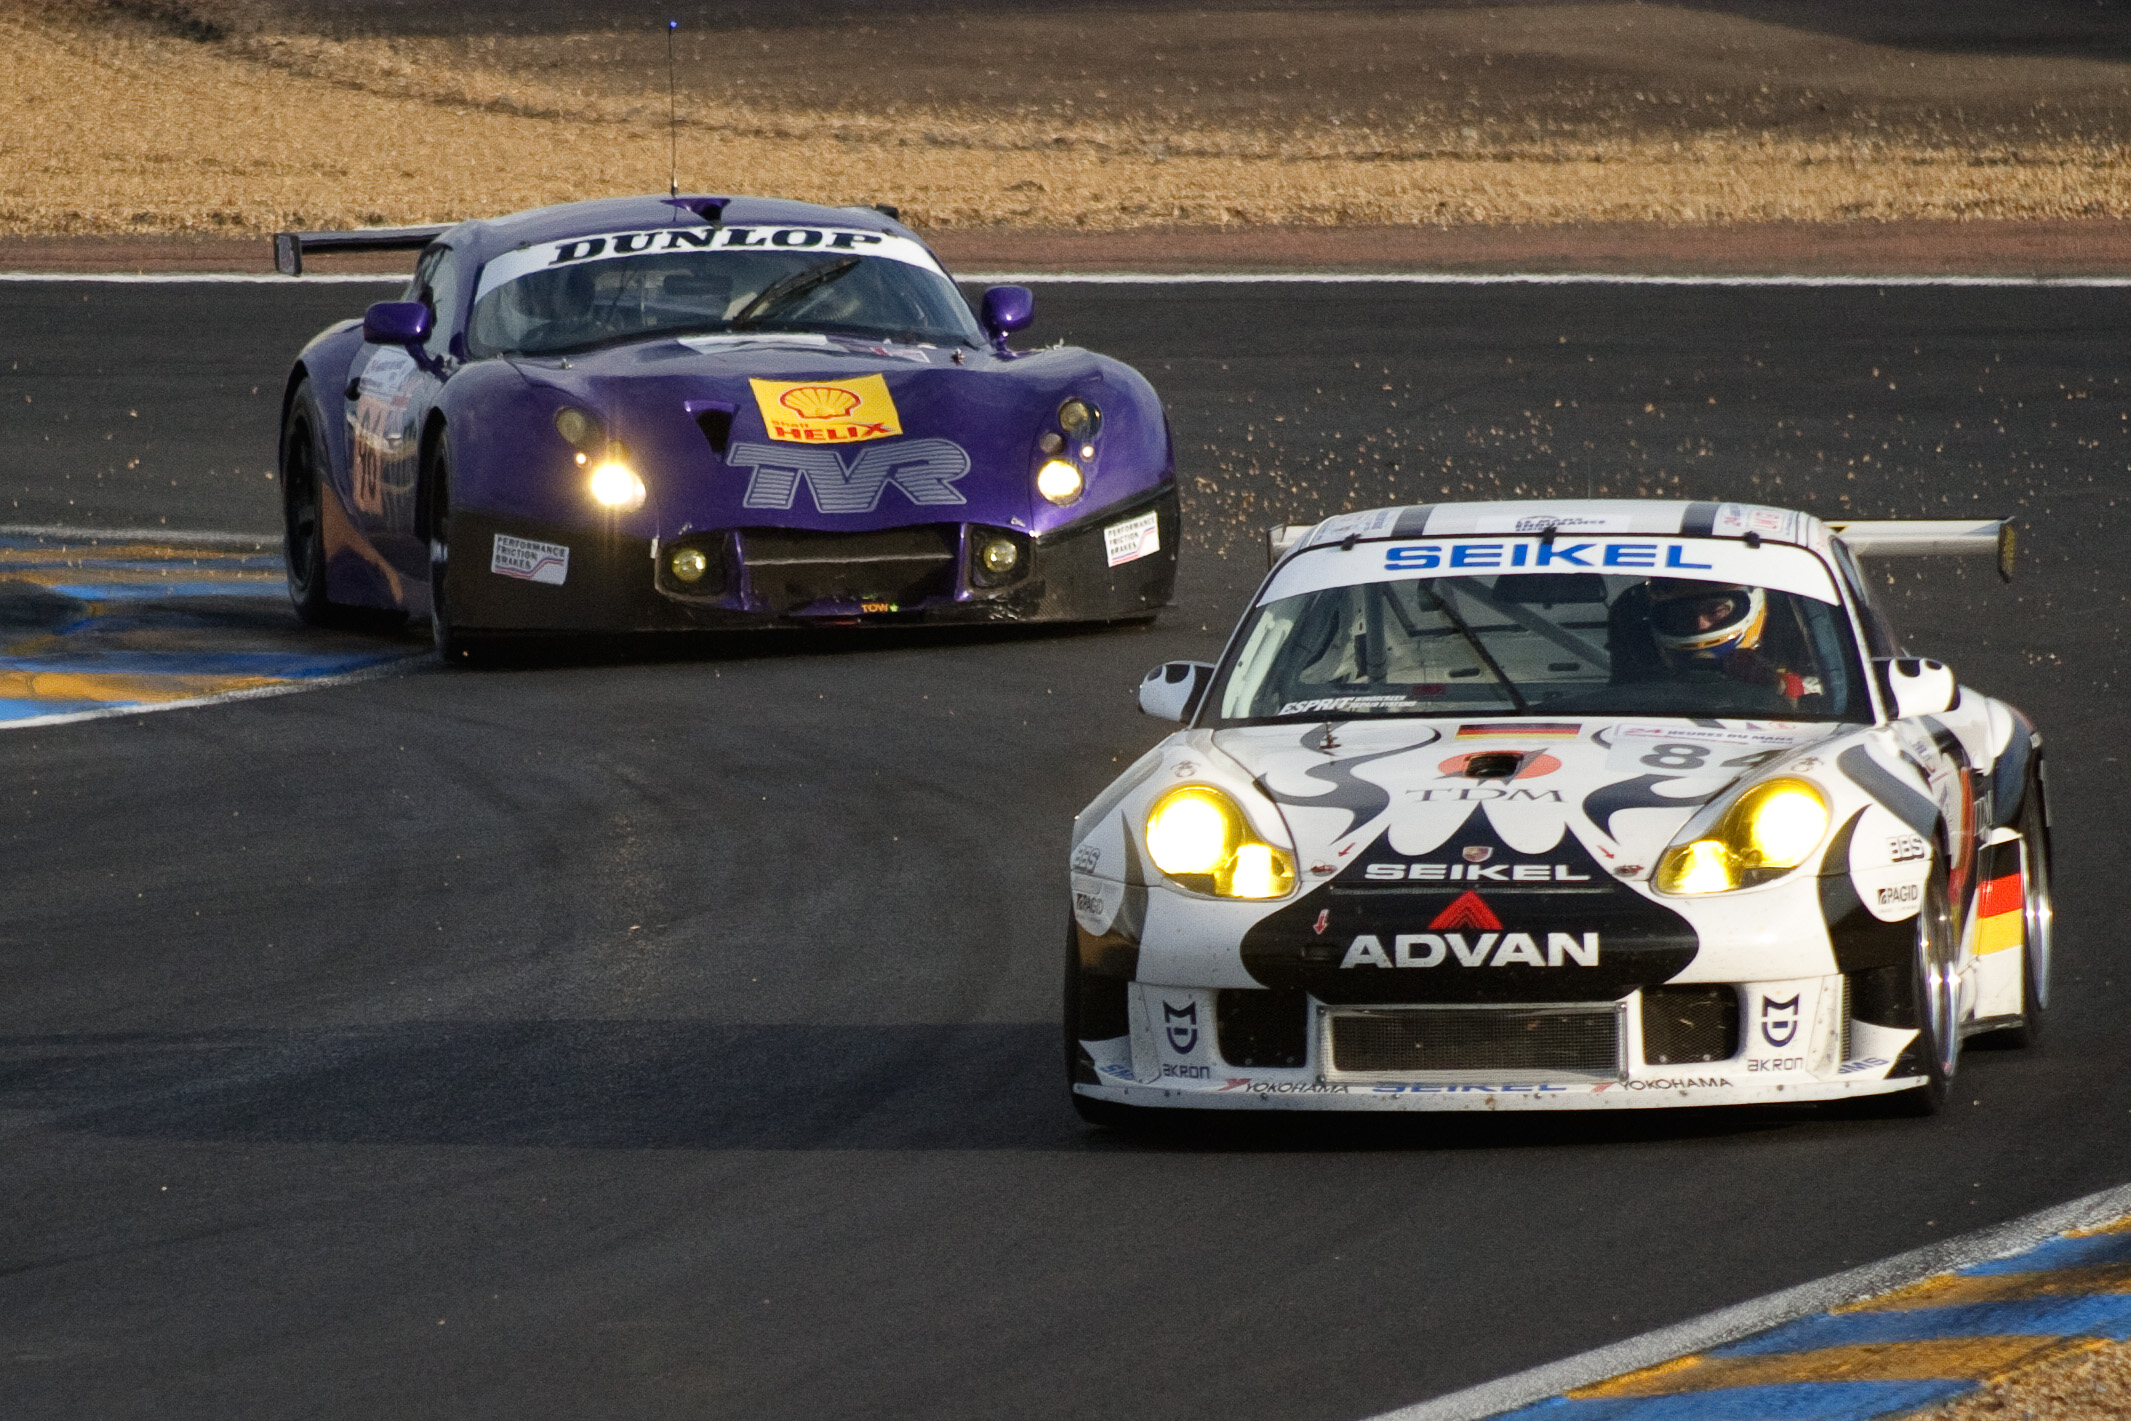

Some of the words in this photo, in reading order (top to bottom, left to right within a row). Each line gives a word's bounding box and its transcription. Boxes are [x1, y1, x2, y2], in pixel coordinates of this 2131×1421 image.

[548, 228, 883, 266] DUNLOP
[774, 422, 892, 441] HELIX
[726, 438, 971, 514] TVR
[1108, 516, 1155, 537] PERFORMANCE
[497, 537, 567, 558] PERFORMANCE
[1109, 531, 1140, 546] FRICTION
[496, 545, 538, 561] FRICTION
[1110, 541, 1138, 557] BRAKES
[1384, 543, 1713, 571] SEIKEL
[495, 554, 532, 570] BRAKES
[861, 603, 889, 613] TOW
[1278, 697, 1356, 715] ESPRIT
[1668, 730, 1723, 738] HEURES
[1405, 788, 1568, 803] TDM
[1887, 834, 1925, 862] BBS
[1364, 863, 1592, 881] SEIKEL
[1887, 884, 1918, 904] PAGID
[1339, 932, 1600, 969] ADVAN
[1245, 1082, 1349, 1094] YOKOHAMA
[1372, 1081, 1567, 1093] SEIKEL
[1621, 1078, 1733, 1091] YOKOHAMA
